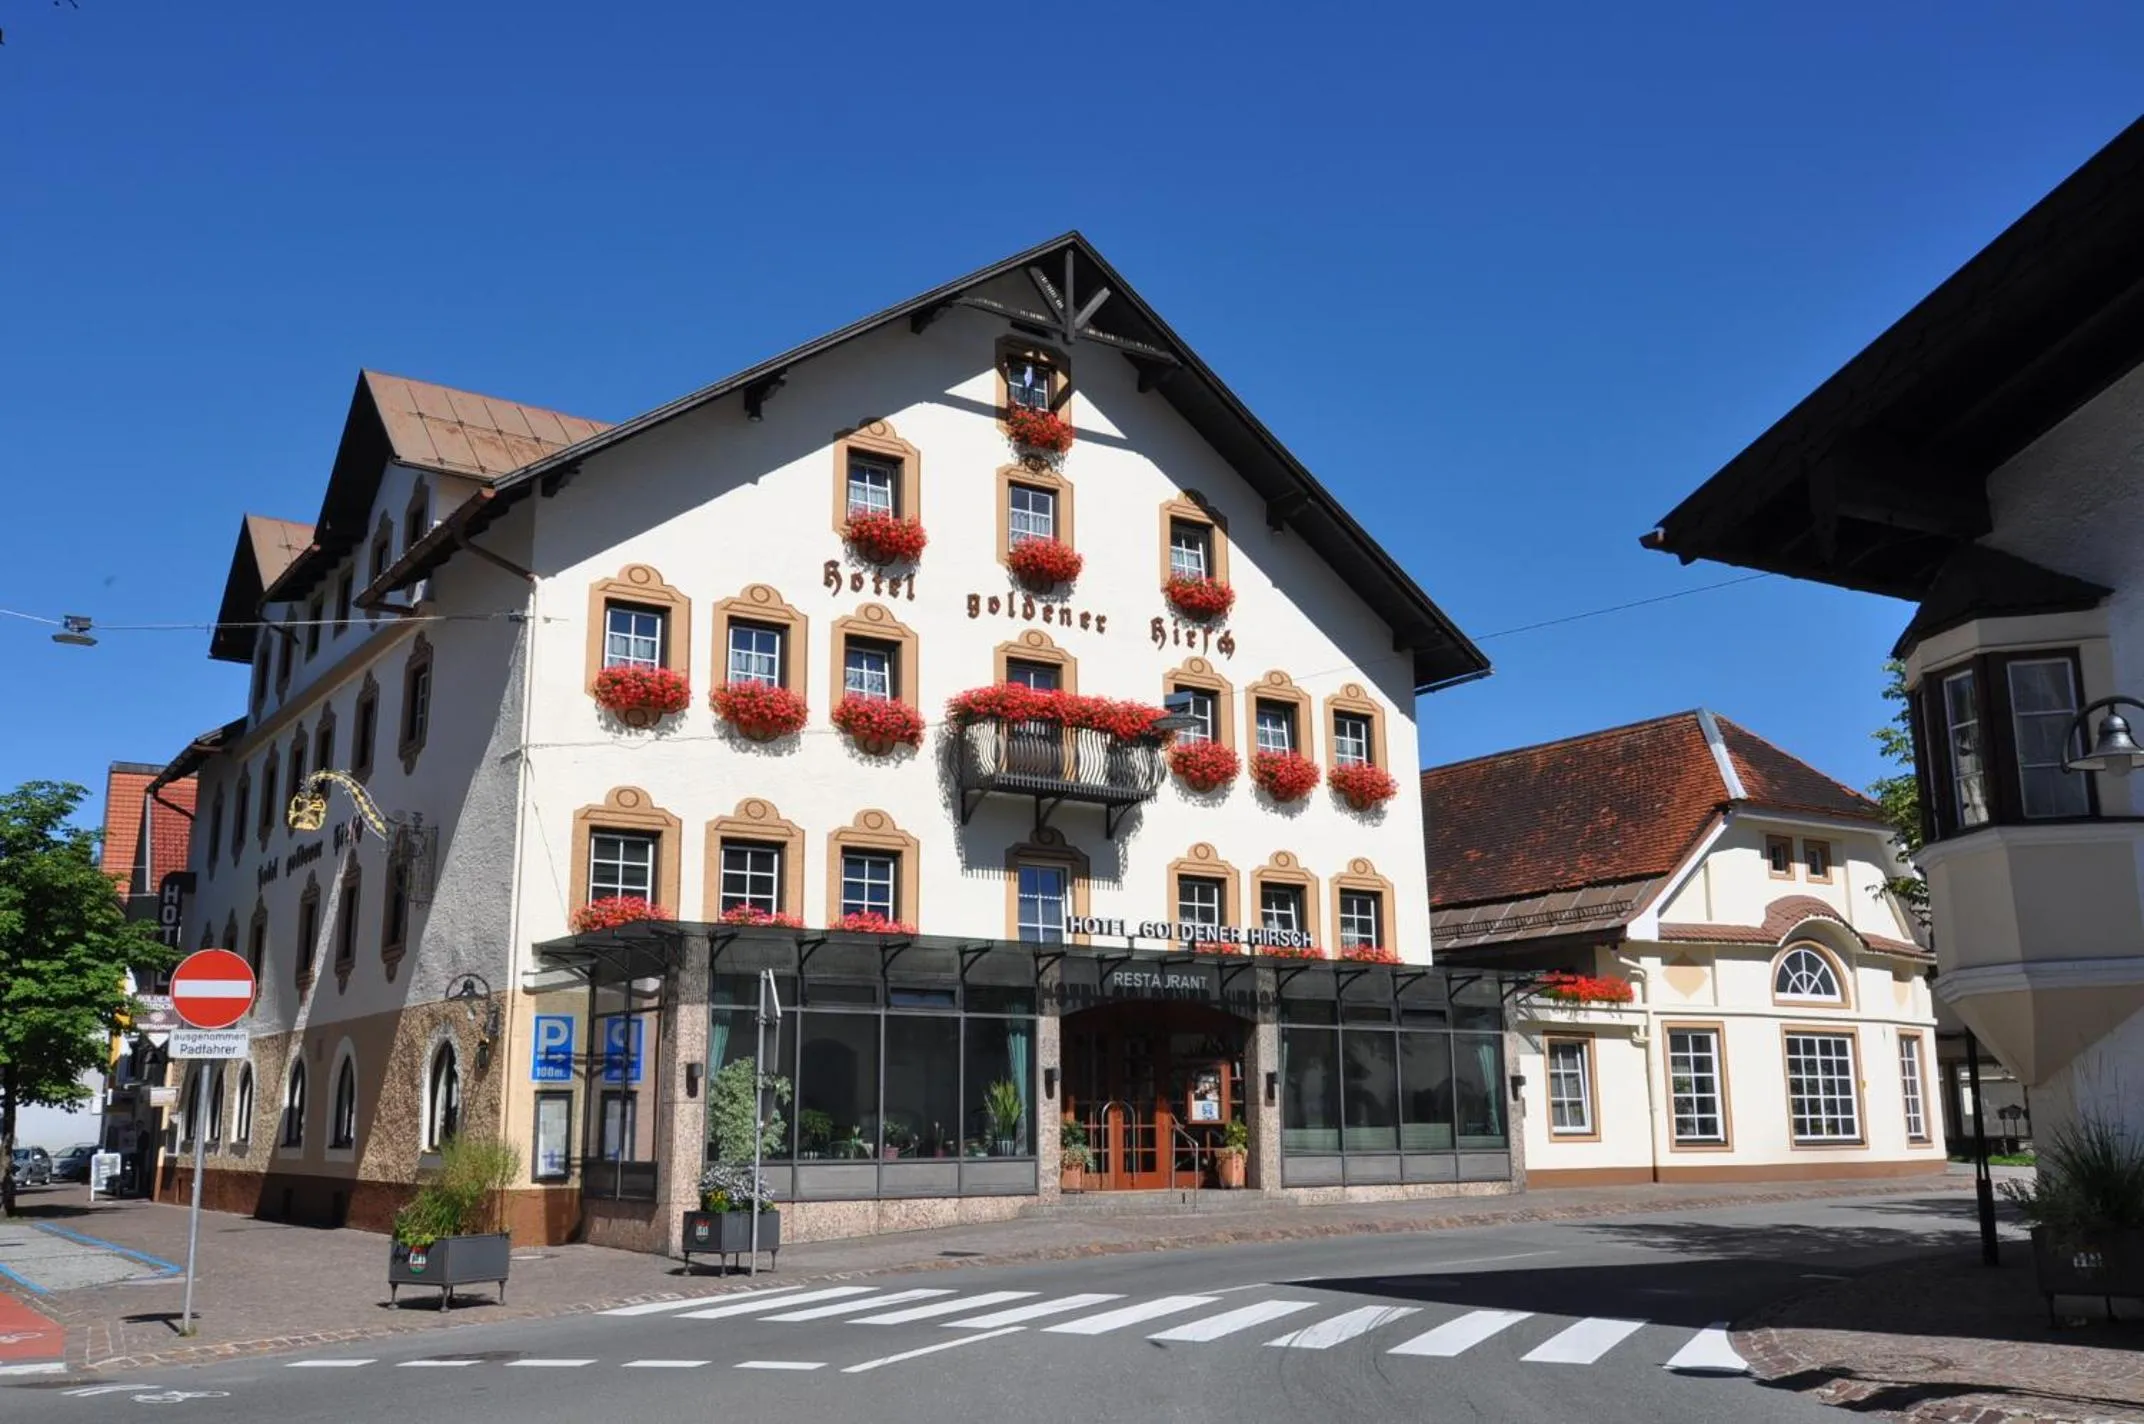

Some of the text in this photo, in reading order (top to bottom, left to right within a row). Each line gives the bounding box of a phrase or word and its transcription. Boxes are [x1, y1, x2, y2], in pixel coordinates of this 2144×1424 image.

[157, 884, 180, 986] HOTL
[1068, 916, 1313, 948] HOTEL GOLDENER HIRSCH
[537, 1019, 569, 1060] P
